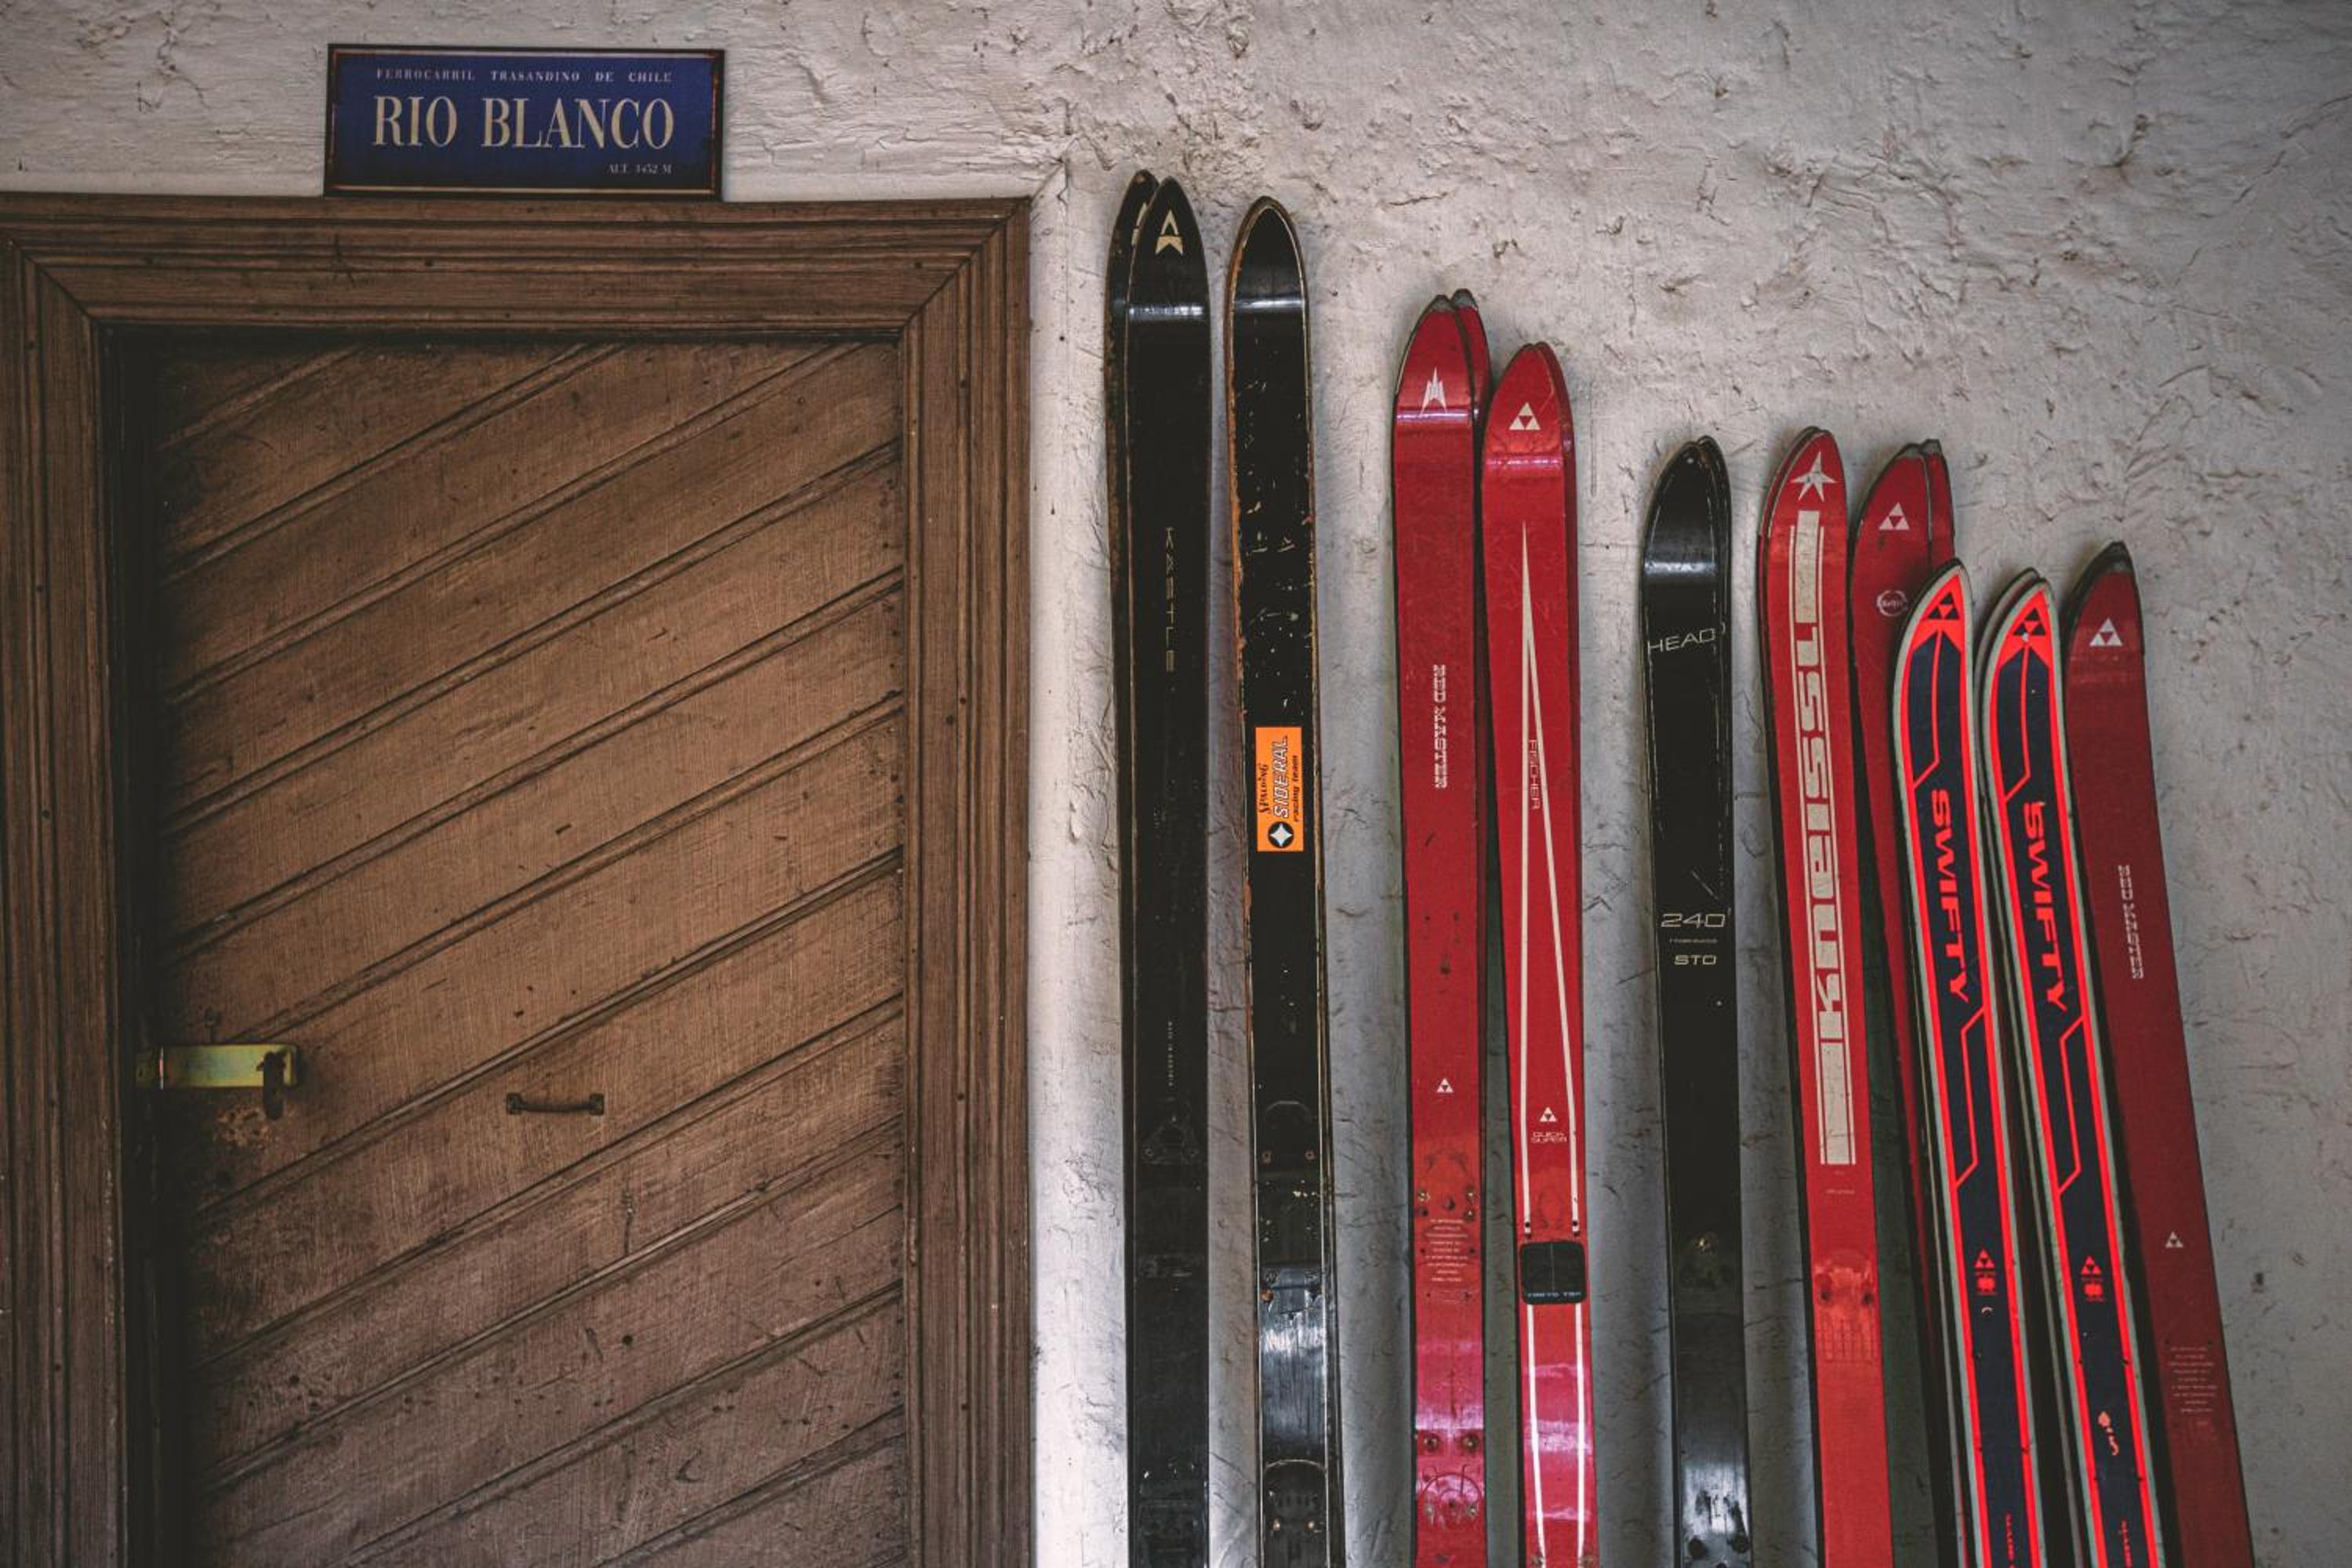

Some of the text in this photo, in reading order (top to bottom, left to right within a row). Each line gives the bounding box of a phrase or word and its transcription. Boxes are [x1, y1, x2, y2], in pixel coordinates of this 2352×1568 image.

[376, 68, 673, 83] FERROCARRIL TRASANDINO DE CHILE
[372, 95, 674, 151] RIO BLANCO
[1647, 627, 1715, 655] HEAD
[1433, 664, 1447, 789] RED MASTER
[1271, 735, 1289, 819] SIDERAL
[1530, 739, 1541, 810] FISCHER
[1661, 913, 1726, 928] 240
[1931, 789, 1969, 1004] SWIFTY
[2023, 802, 2067, 1012] SWIFTY
